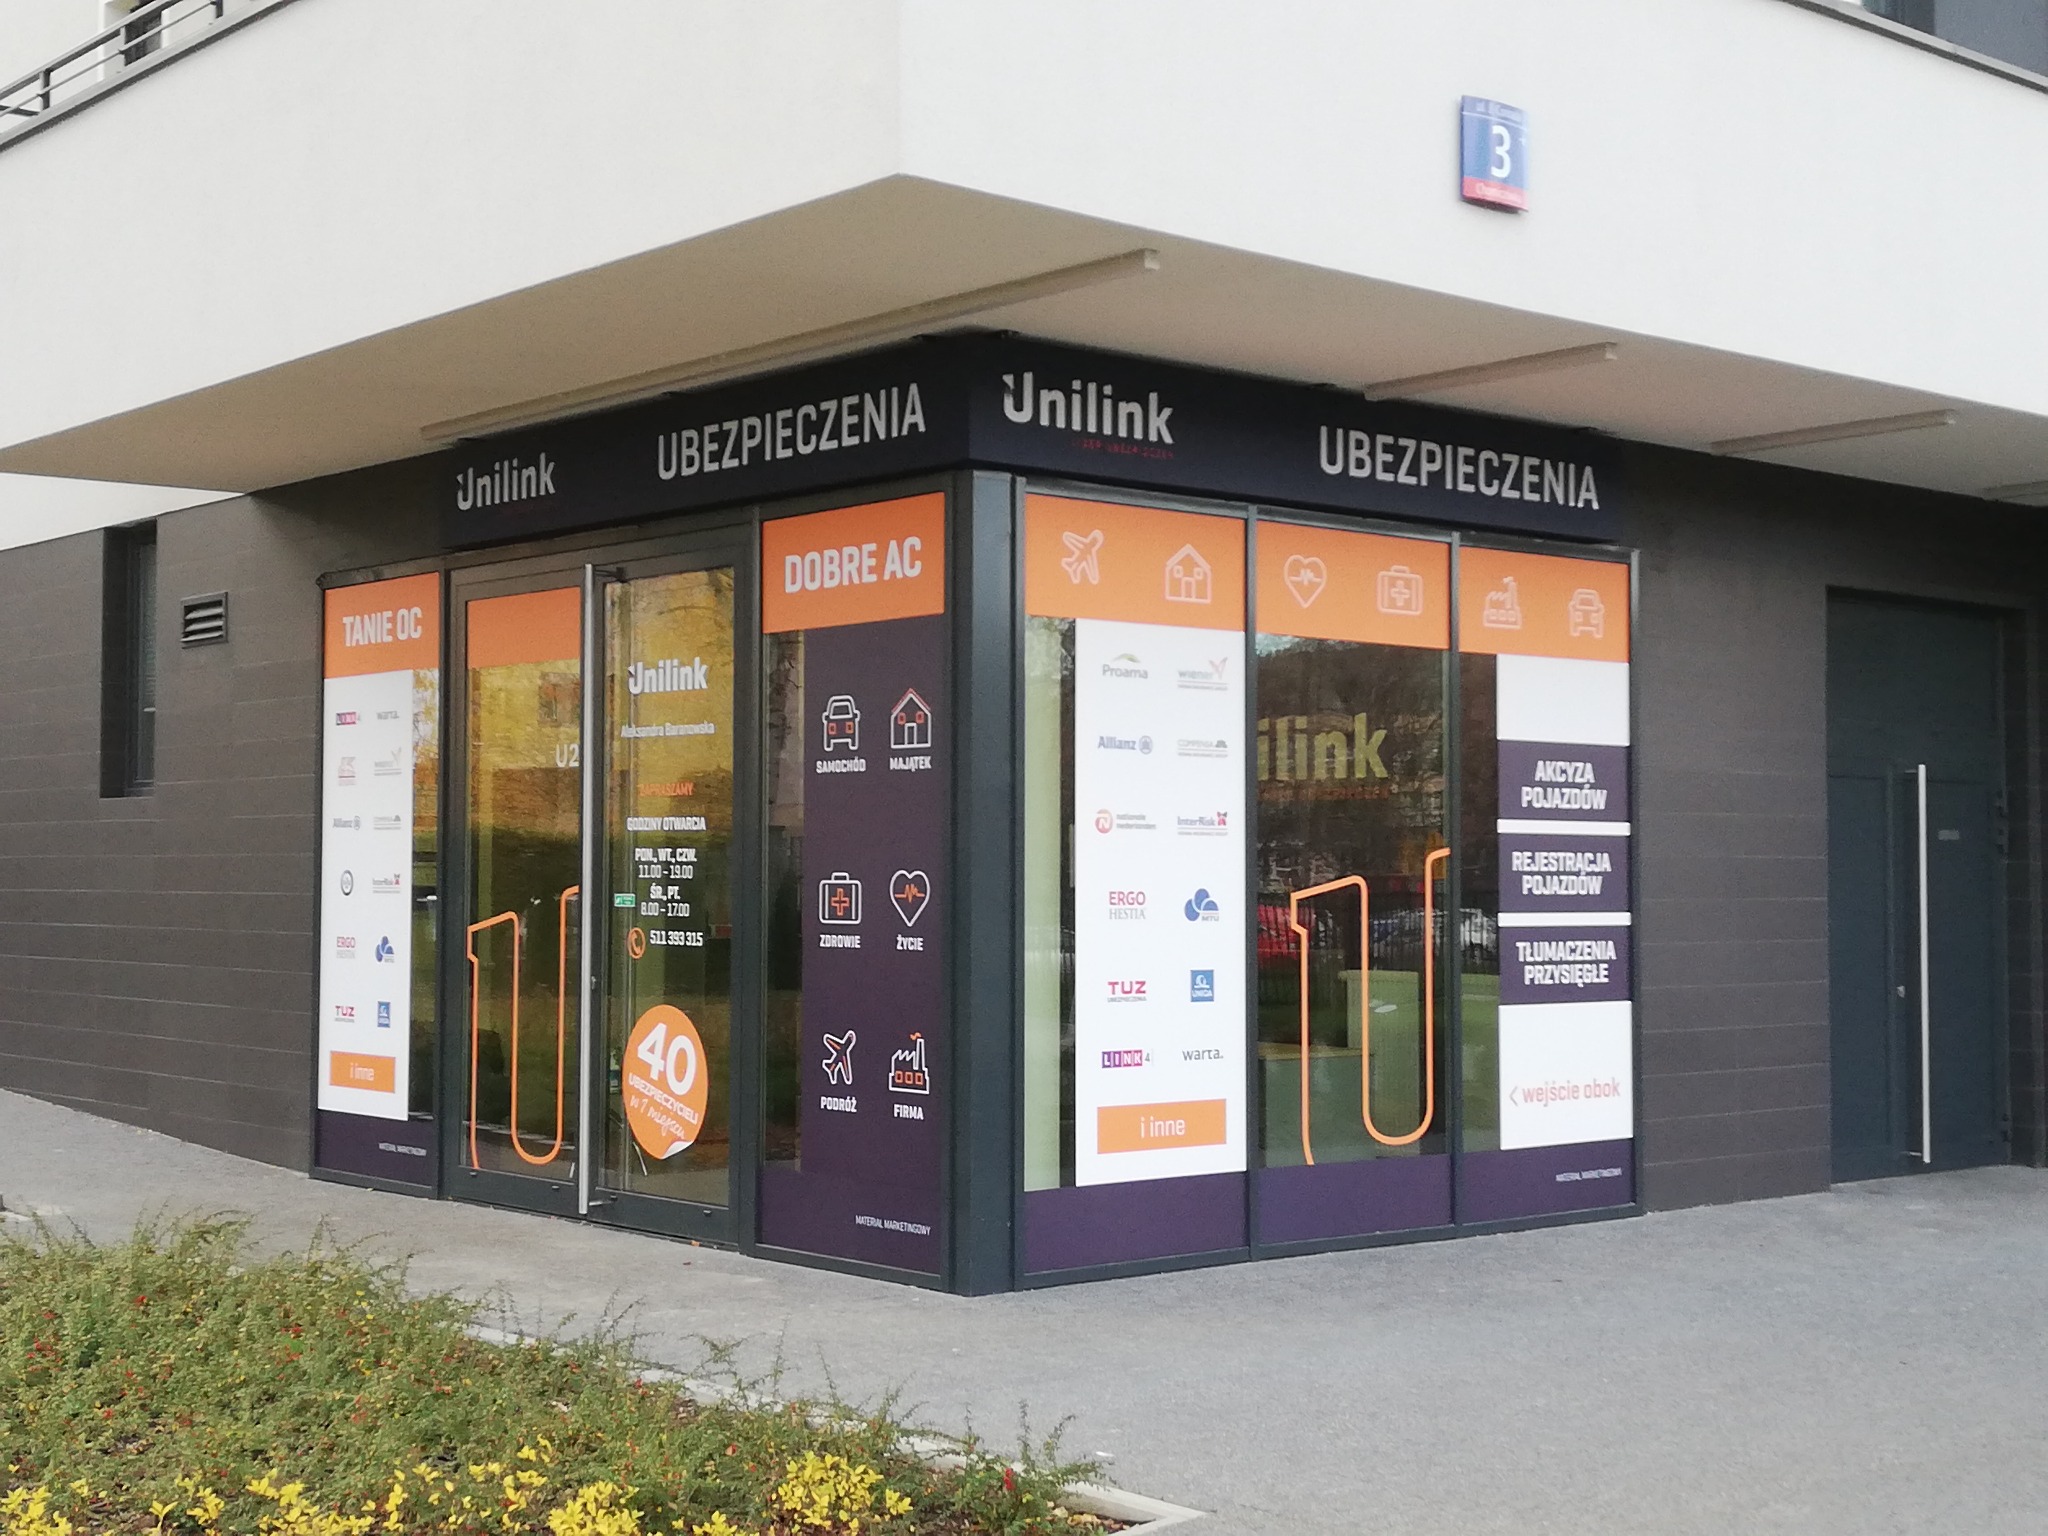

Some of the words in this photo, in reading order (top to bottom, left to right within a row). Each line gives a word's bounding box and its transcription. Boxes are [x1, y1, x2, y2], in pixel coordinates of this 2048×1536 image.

[1490, 124, 1512, 179] 3
[1002, 371, 1175, 444] Unilink
[657, 382, 927, 481] UBEZPIECZENIA
[1319, 425, 1601, 510] UBEZPIECZENIA
[456, 452, 557, 511] Unilink
[785, 542, 878, 594] DOBRE
[883, 536, 922, 581] AC
[342, 610, 394, 647] TANIE
[396, 606, 423, 641] OC
[628, 656, 709, 695] Unilink
[1102, 664, 1149, 680] Proama
[1098, 736, 1137, 750] Allianz
[1257, 712, 1389, 781] ilink
[555, 744, 579, 768] U2
[816, 757, 866, 773] SAMOCHÓD
[890, 756, 932, 772] MAJĄTEK
[1534, 760, 1596, 783] AKCYZA
[639, 782, 694, 796] ZAPRASZAMY
[1521, 784, 1608, 810] POJAZDÓW
[627, 818, 662, 831] GODZINY
[662, 817, 706, 831] OTWARCIA
[669, 865, 694, 879] 19.00
[1511, 851, 1612, 873] REJESTRACJA
[1522, 872, 1603, 896] POJAZDÓW
[1109, 891, 1147, 906] ERGO
[667, 903, 690, 917] 17.00
[1109, 907, 1147, 920] HESTIA
[336, 936, 356, 949] ERGO
[650, 930, 667, 945] 511
[667, 931, 685, 946] 393
[685, 932, 704, 947] 315
[819, 934, 861, 949] ZDROWIE
[896, 934, 924, 951] ŻYCIE
[1515, 940, 1617, 962] TŁUMACZENIA
[1524, 963, 1610, 987] PRZYSIĘGŁE
[1107, 980, 1147, 996] TUZ
[335, 1005, 355, 1017] TUZ
[637, 1022, 697, 1096] 40
[1522, 1080, 1581, 1107] wejście
[1583, 1077, 1621, 1099] obok
[820, 1096, 857, 1113] PODRÓŻ
[893, 1104, 924, 1120] FIRMA
[1140, 1117, 1145, 1139] i
[1150, 1115, 1186, 1137] inne
